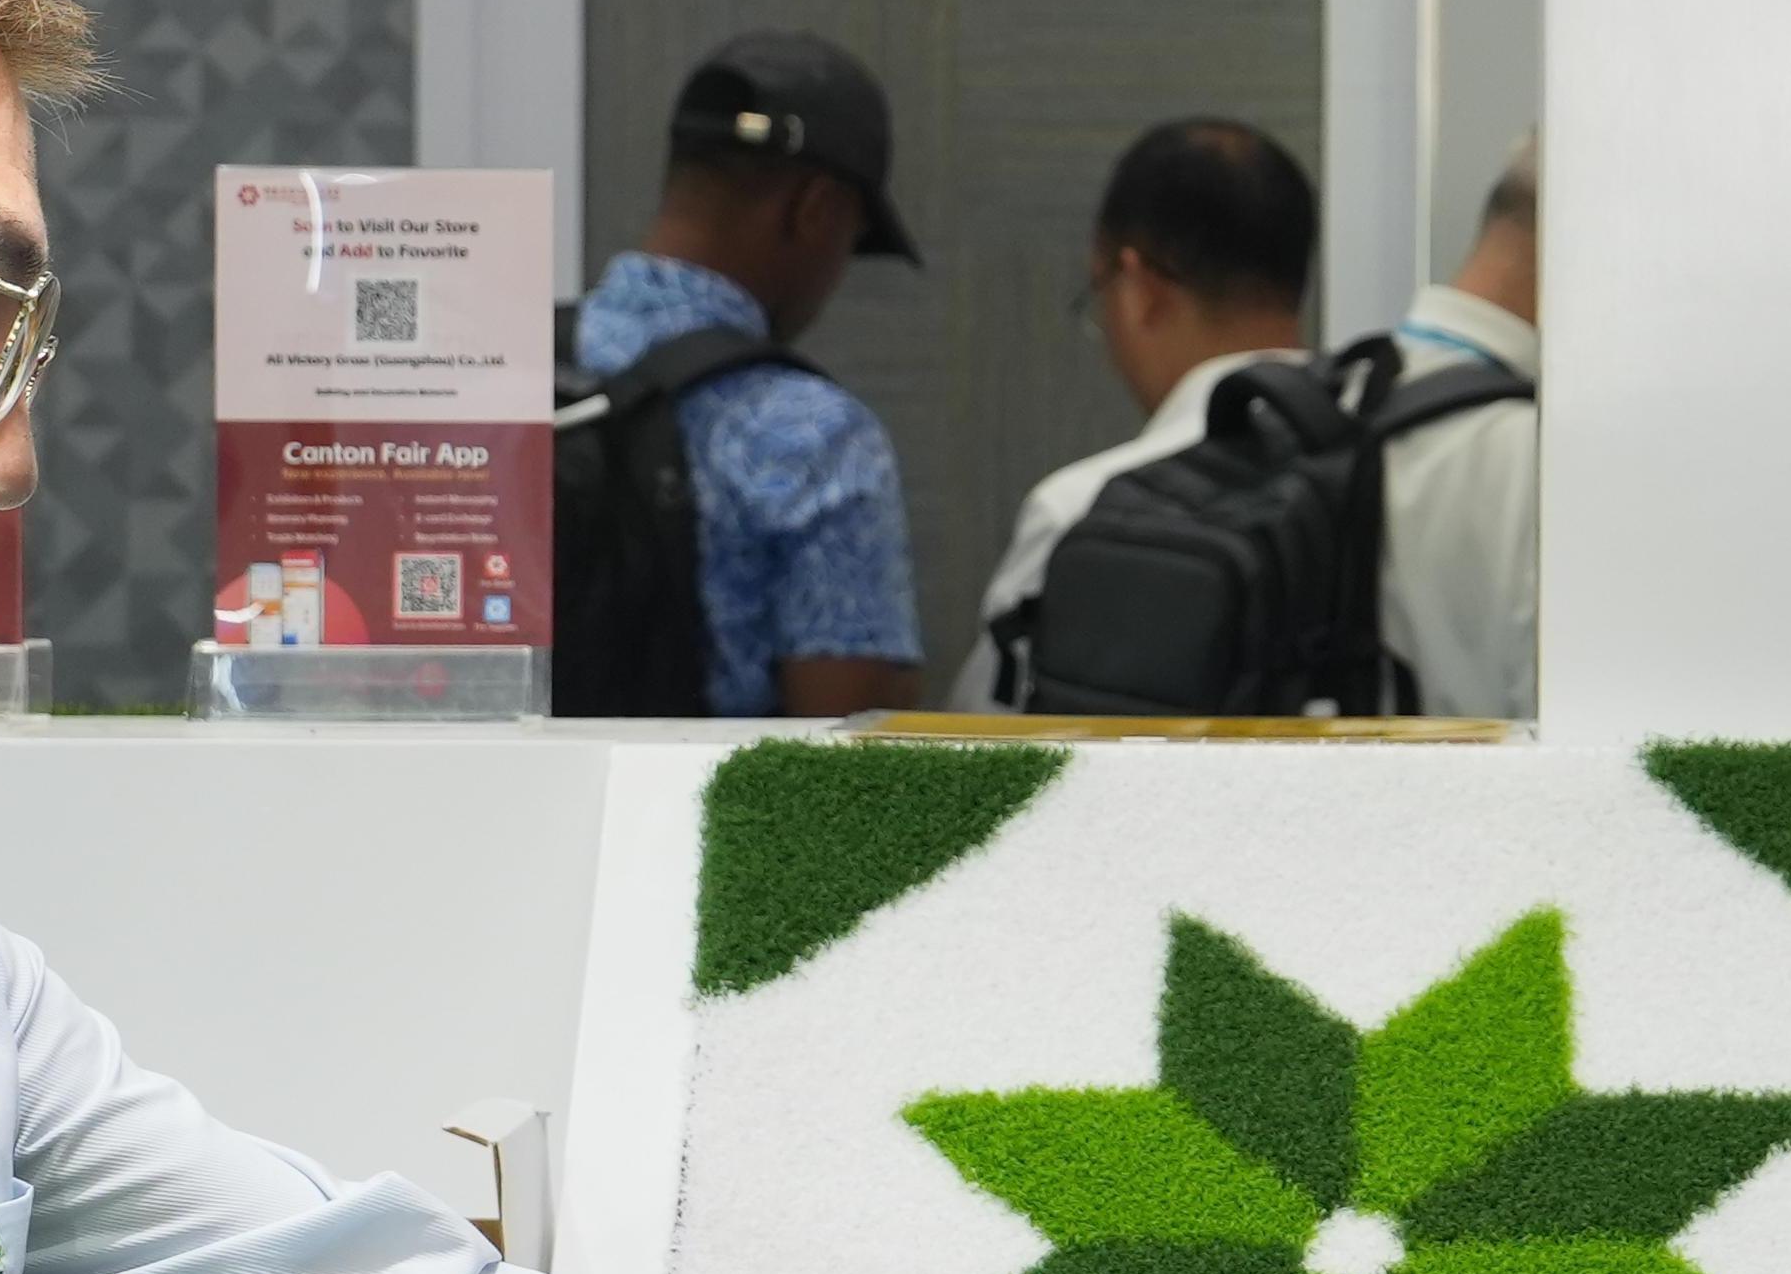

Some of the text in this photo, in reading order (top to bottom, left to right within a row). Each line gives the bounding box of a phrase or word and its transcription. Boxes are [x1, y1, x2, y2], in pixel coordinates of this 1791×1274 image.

[337, 219, 354, 233] to
[360, 218, 396, 233] Visit
[400, 219, 429, 233] Our
[435, 219, 480, 233] Store
[340, 243, 374, 258] Add
[377, 244, 395, 258] to
[399, 243, 469, 258] Favorite
[282, 441, 490, 468] Canton Fair App
